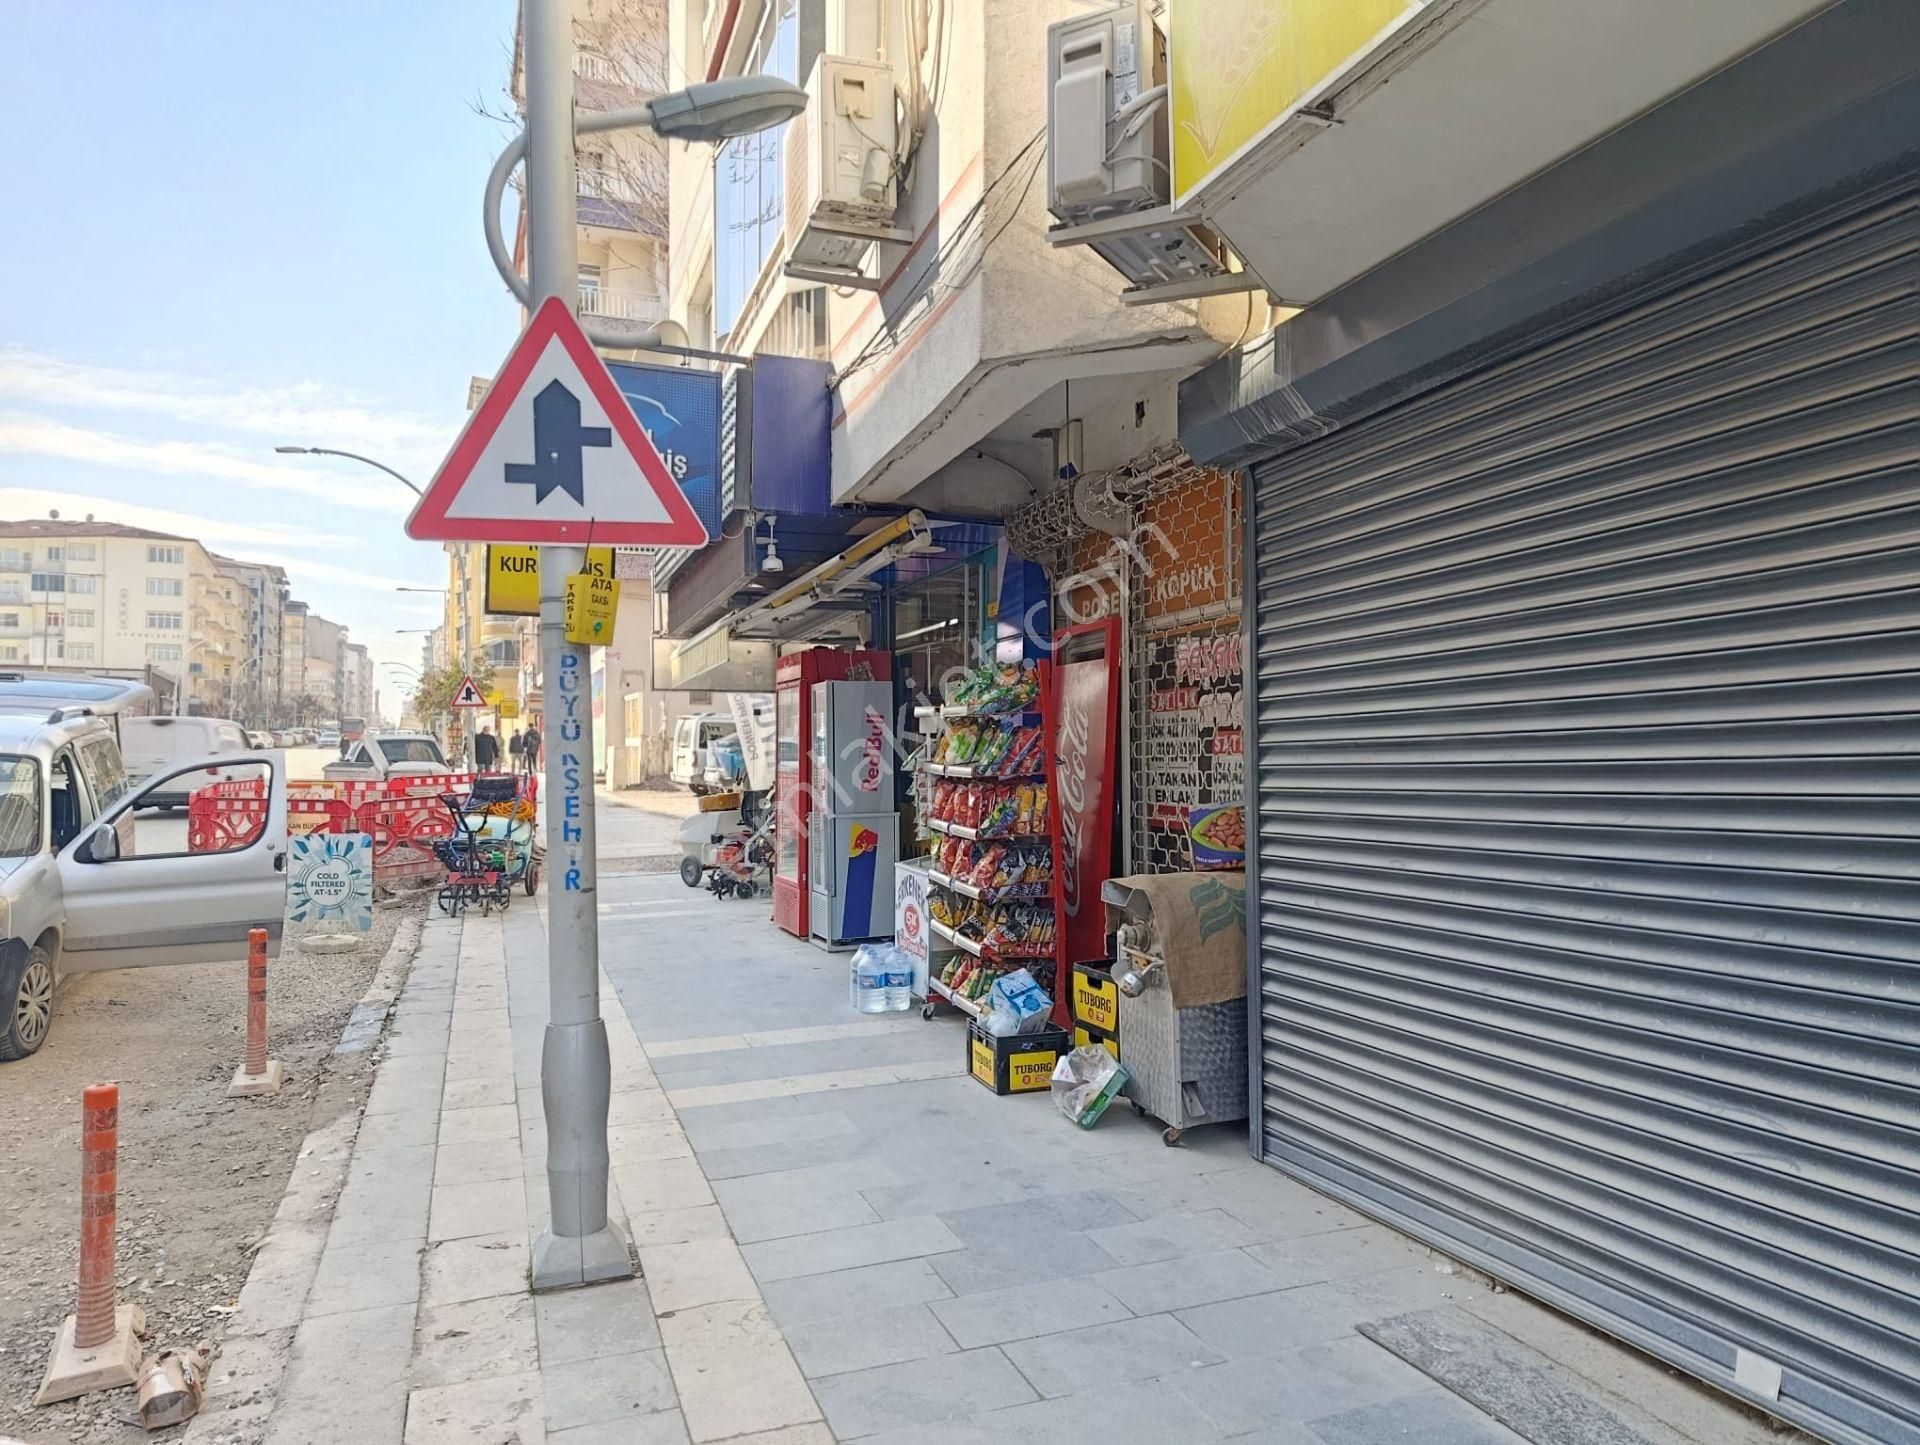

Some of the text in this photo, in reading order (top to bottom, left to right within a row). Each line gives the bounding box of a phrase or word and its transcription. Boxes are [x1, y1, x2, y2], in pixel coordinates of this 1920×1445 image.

[590, 578, 612, 592] ATA
[316, 872, 339, 880] COLD
[310, 880, 346, 888] FILTERED
[1079, 989, 1112, 1014] TUBORG
[1014, 1062, 1052, 1075] TUBORG
